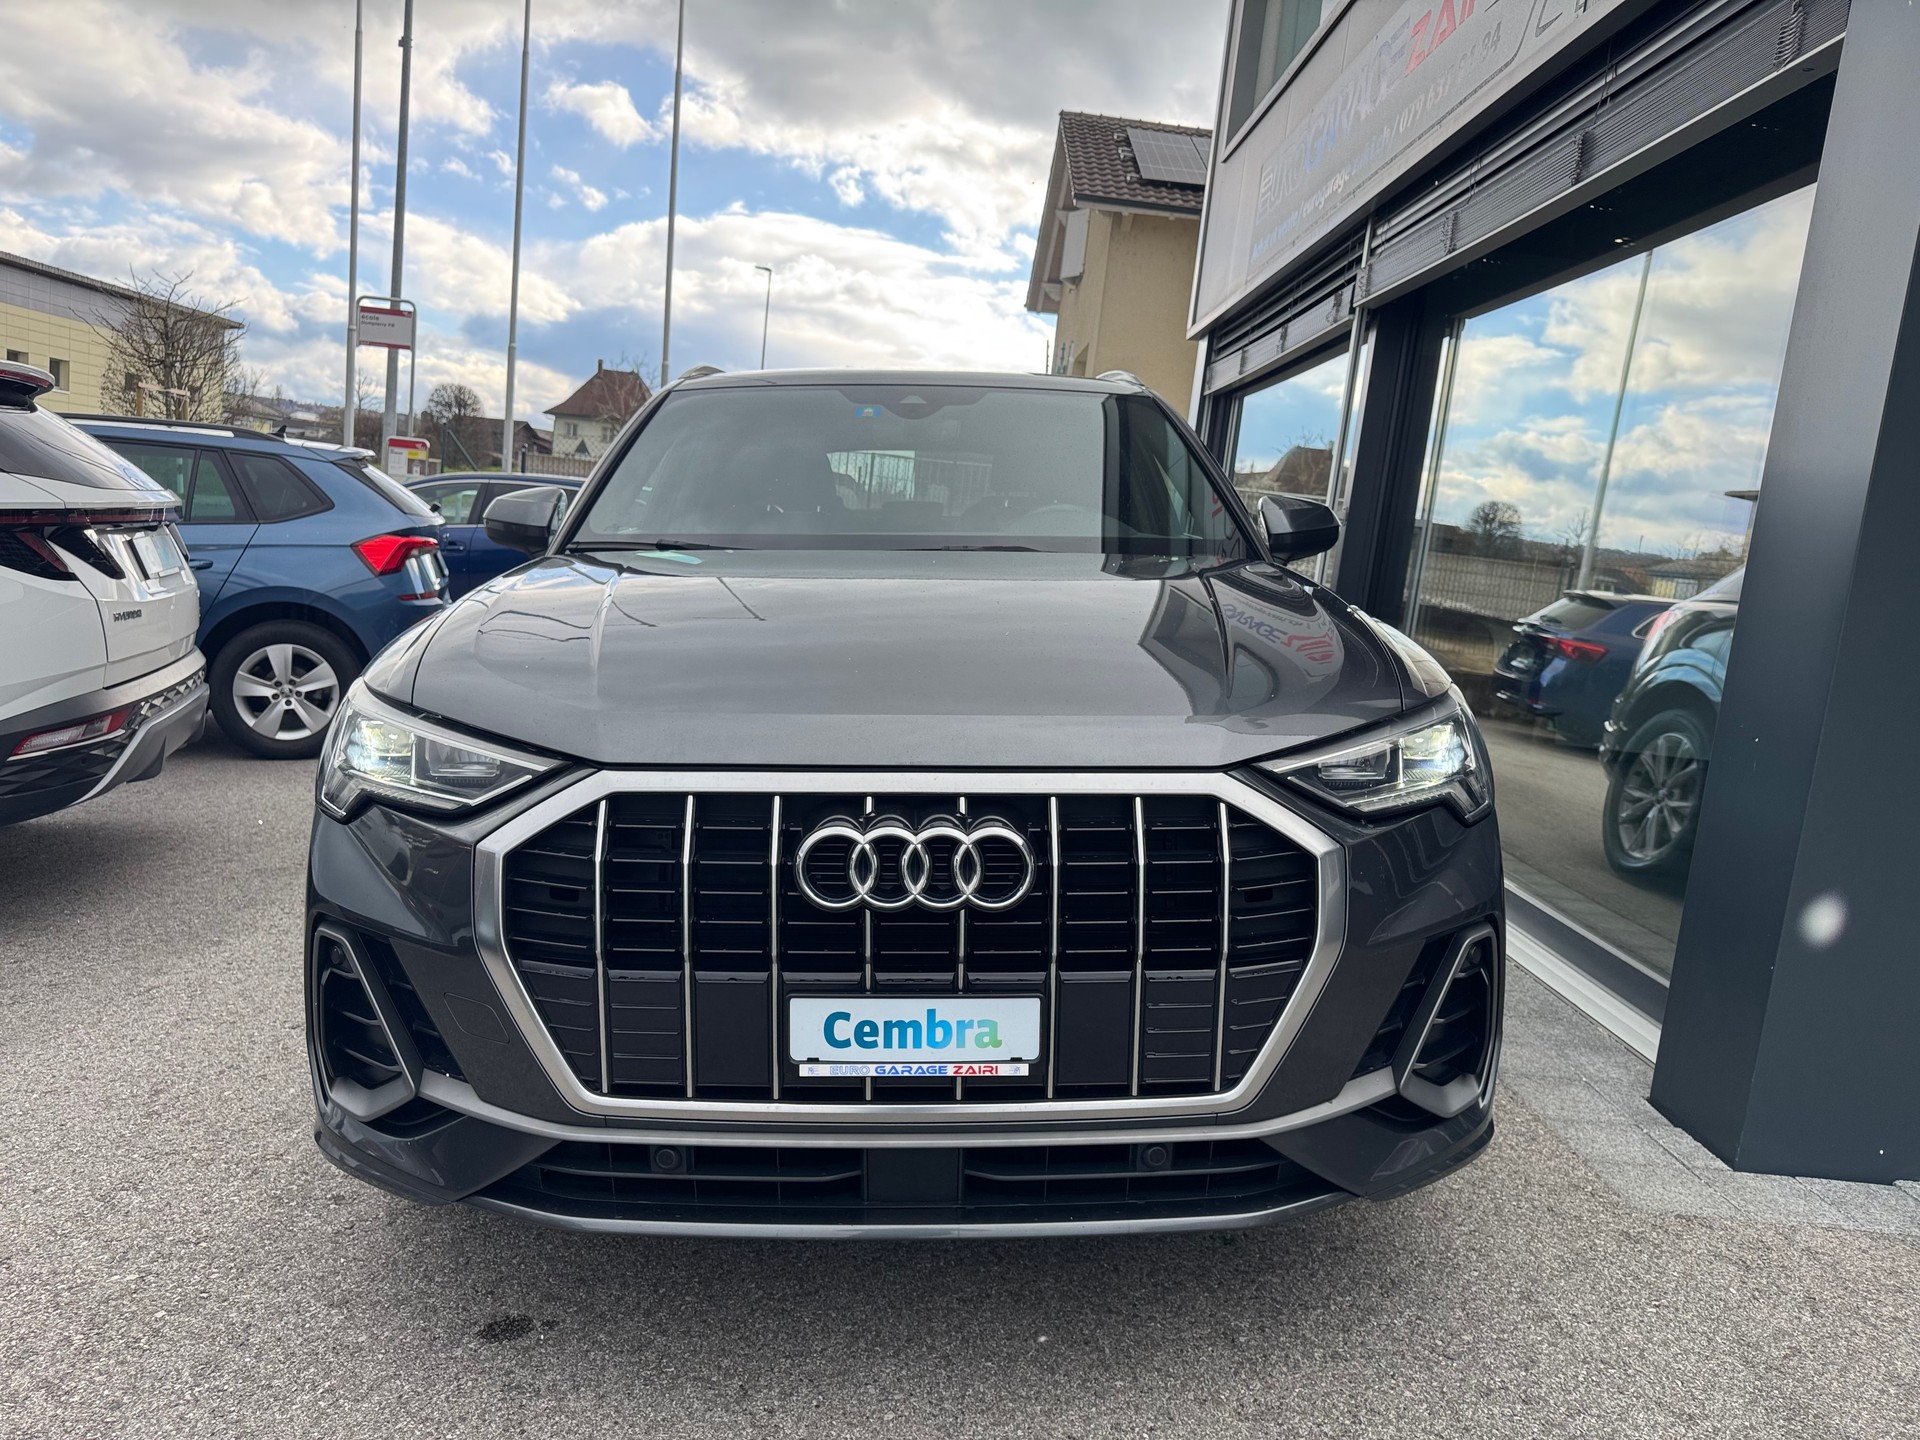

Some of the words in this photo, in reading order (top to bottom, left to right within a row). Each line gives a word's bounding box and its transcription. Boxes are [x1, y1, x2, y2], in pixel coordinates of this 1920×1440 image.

[823, 1008, 1003, 1049] Cembra
[829, 1065, 871, 1075] EURO
[874, 1065, 948, 1075] GARAGE
[953, 1065, 999, 1075] ZAIRI
